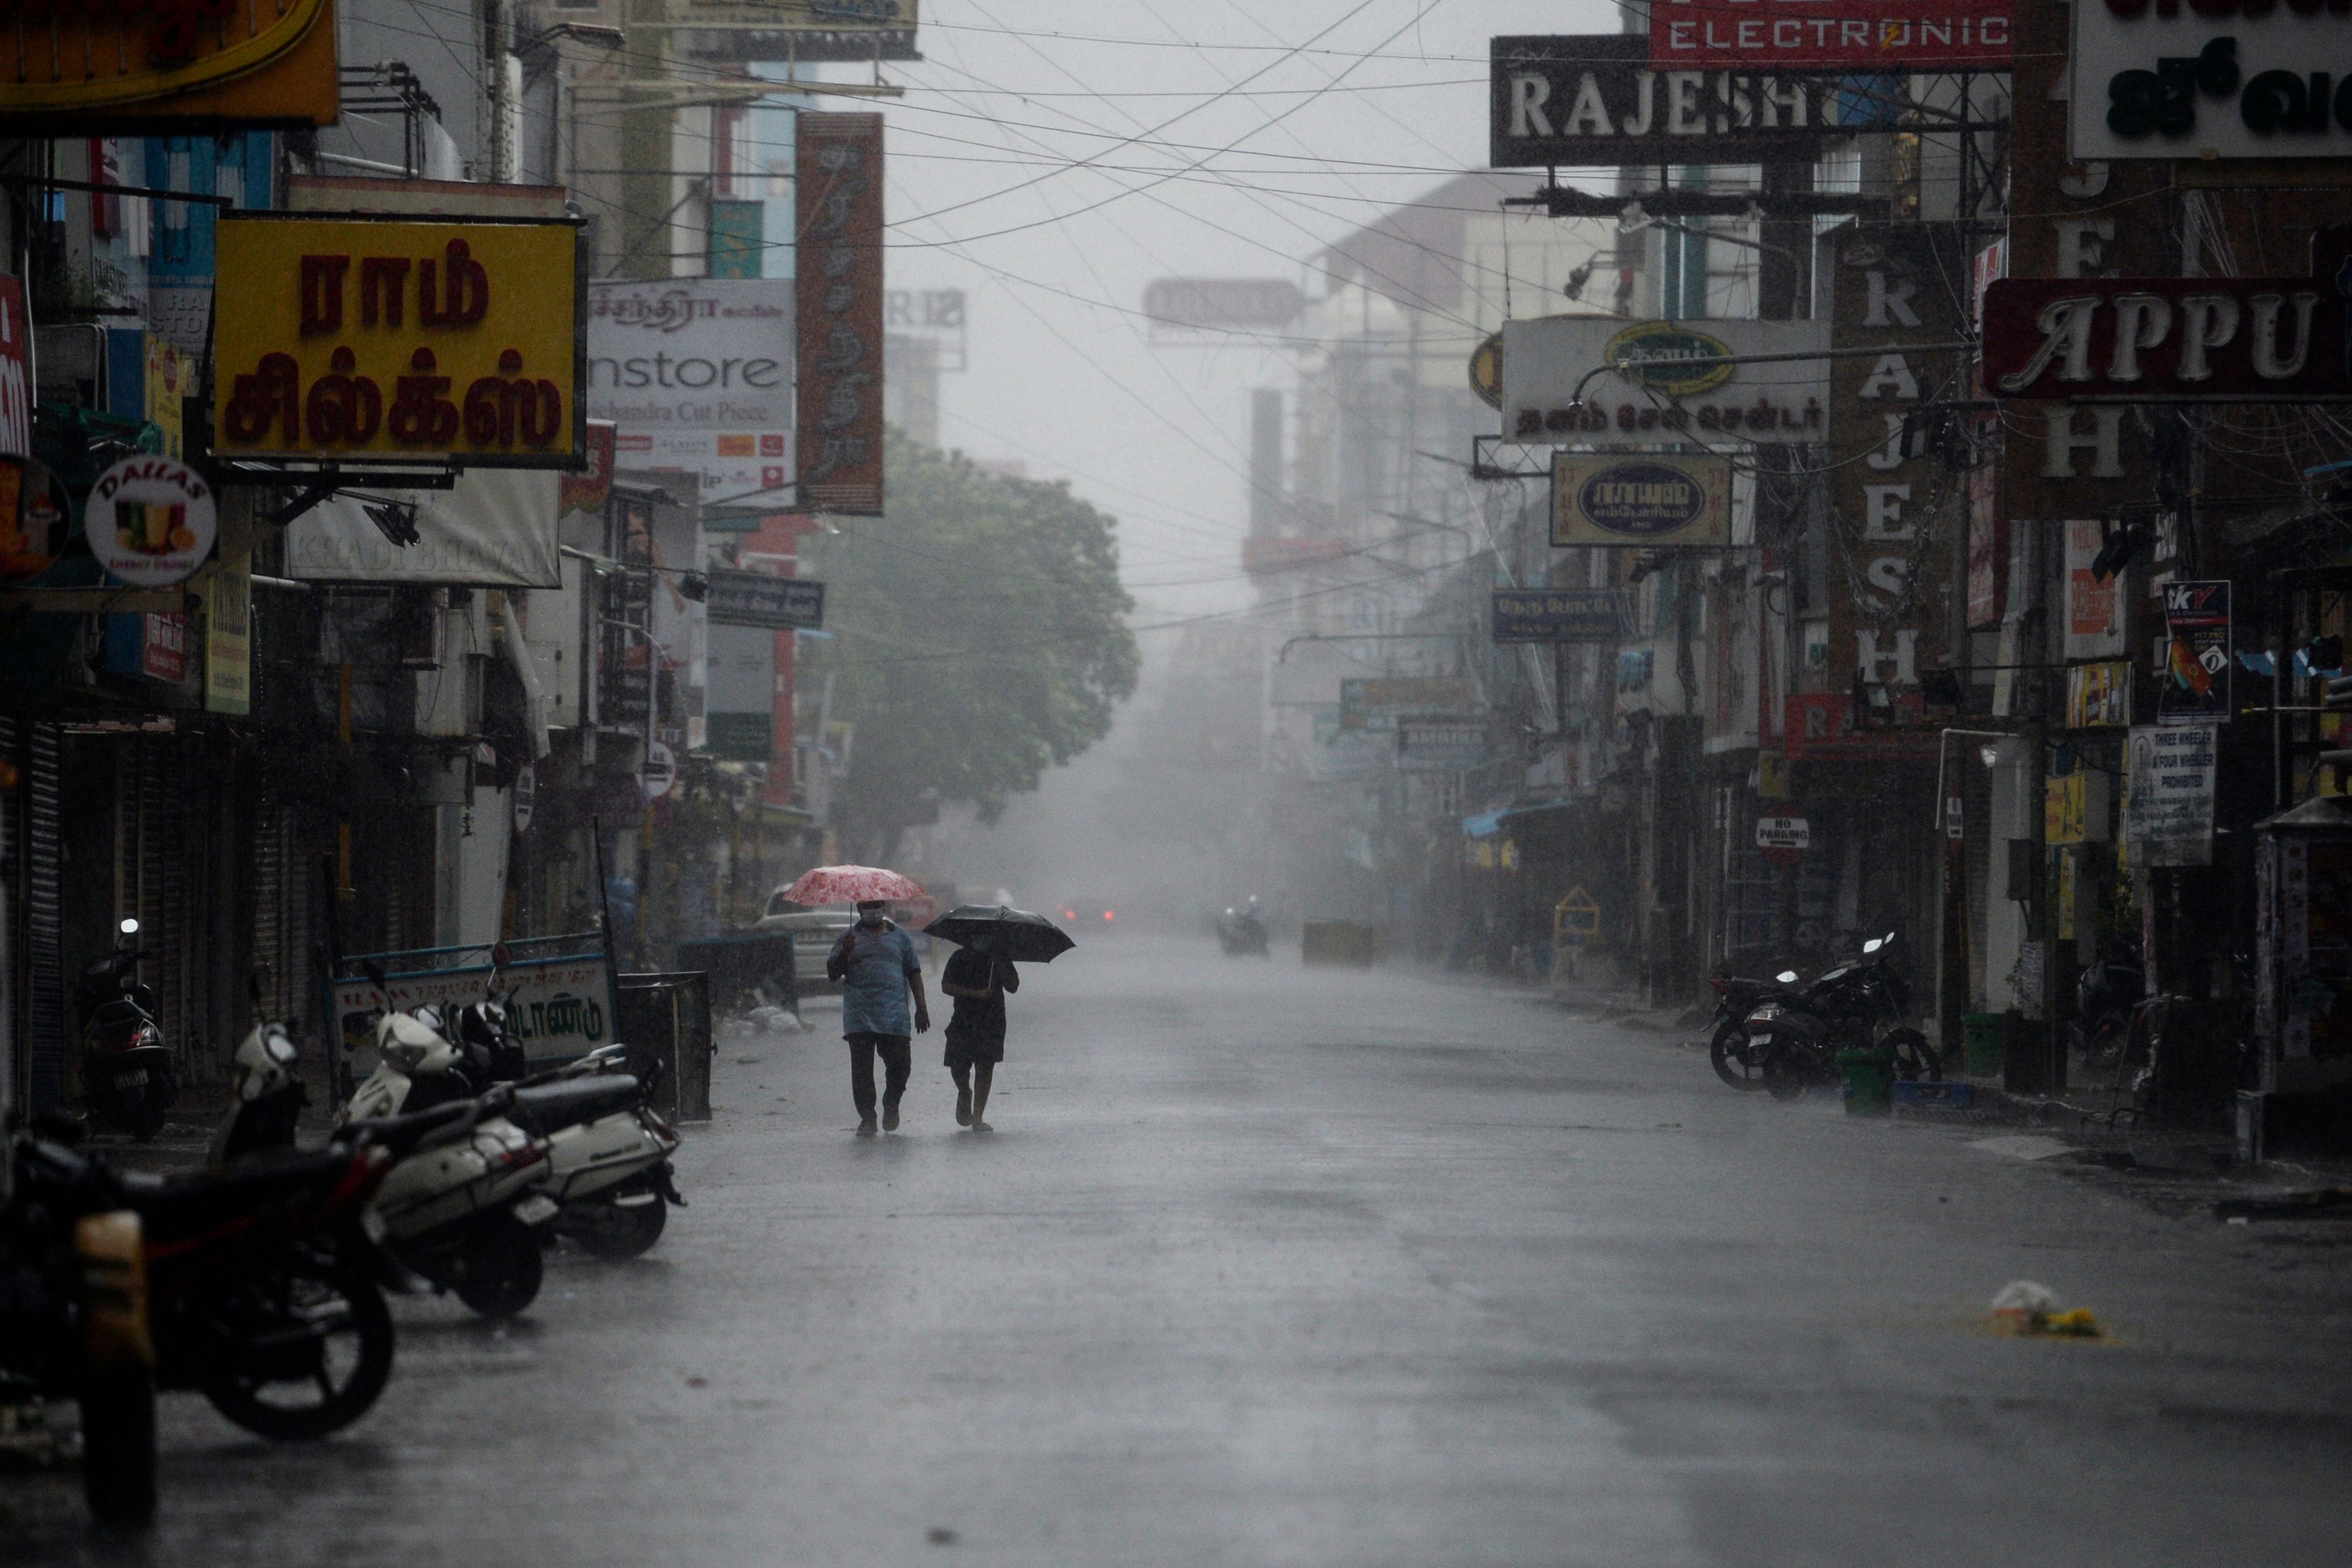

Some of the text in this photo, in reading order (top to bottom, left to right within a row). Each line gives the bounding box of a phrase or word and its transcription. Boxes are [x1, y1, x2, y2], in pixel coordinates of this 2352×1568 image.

[1670, 17, 2009, 50] ELECTRONIC
[1508, 71, 1807, 138] RAJESH
[300, 238, 489, 336] ராம்
[1999, 292, 2318, 391] APPU
[225, 346, 562, 447] சில்க்ஸ்
[678, 401, 712, 421] Cut
[718, 401, 767, 421] Piece
[97, 461, 206, 501] DALLAS
[2155, 731, 2212, 746] THREE WHEELER
[2159, 754, 2178, 768] FOUR
[2180, 753, 2213, 767] WHEELER
[2162, 774, 2204, 789] PROHIBITED
[1759, 829, 1808, 840] PARKING
[1774, 819, 1791, 829] NO
